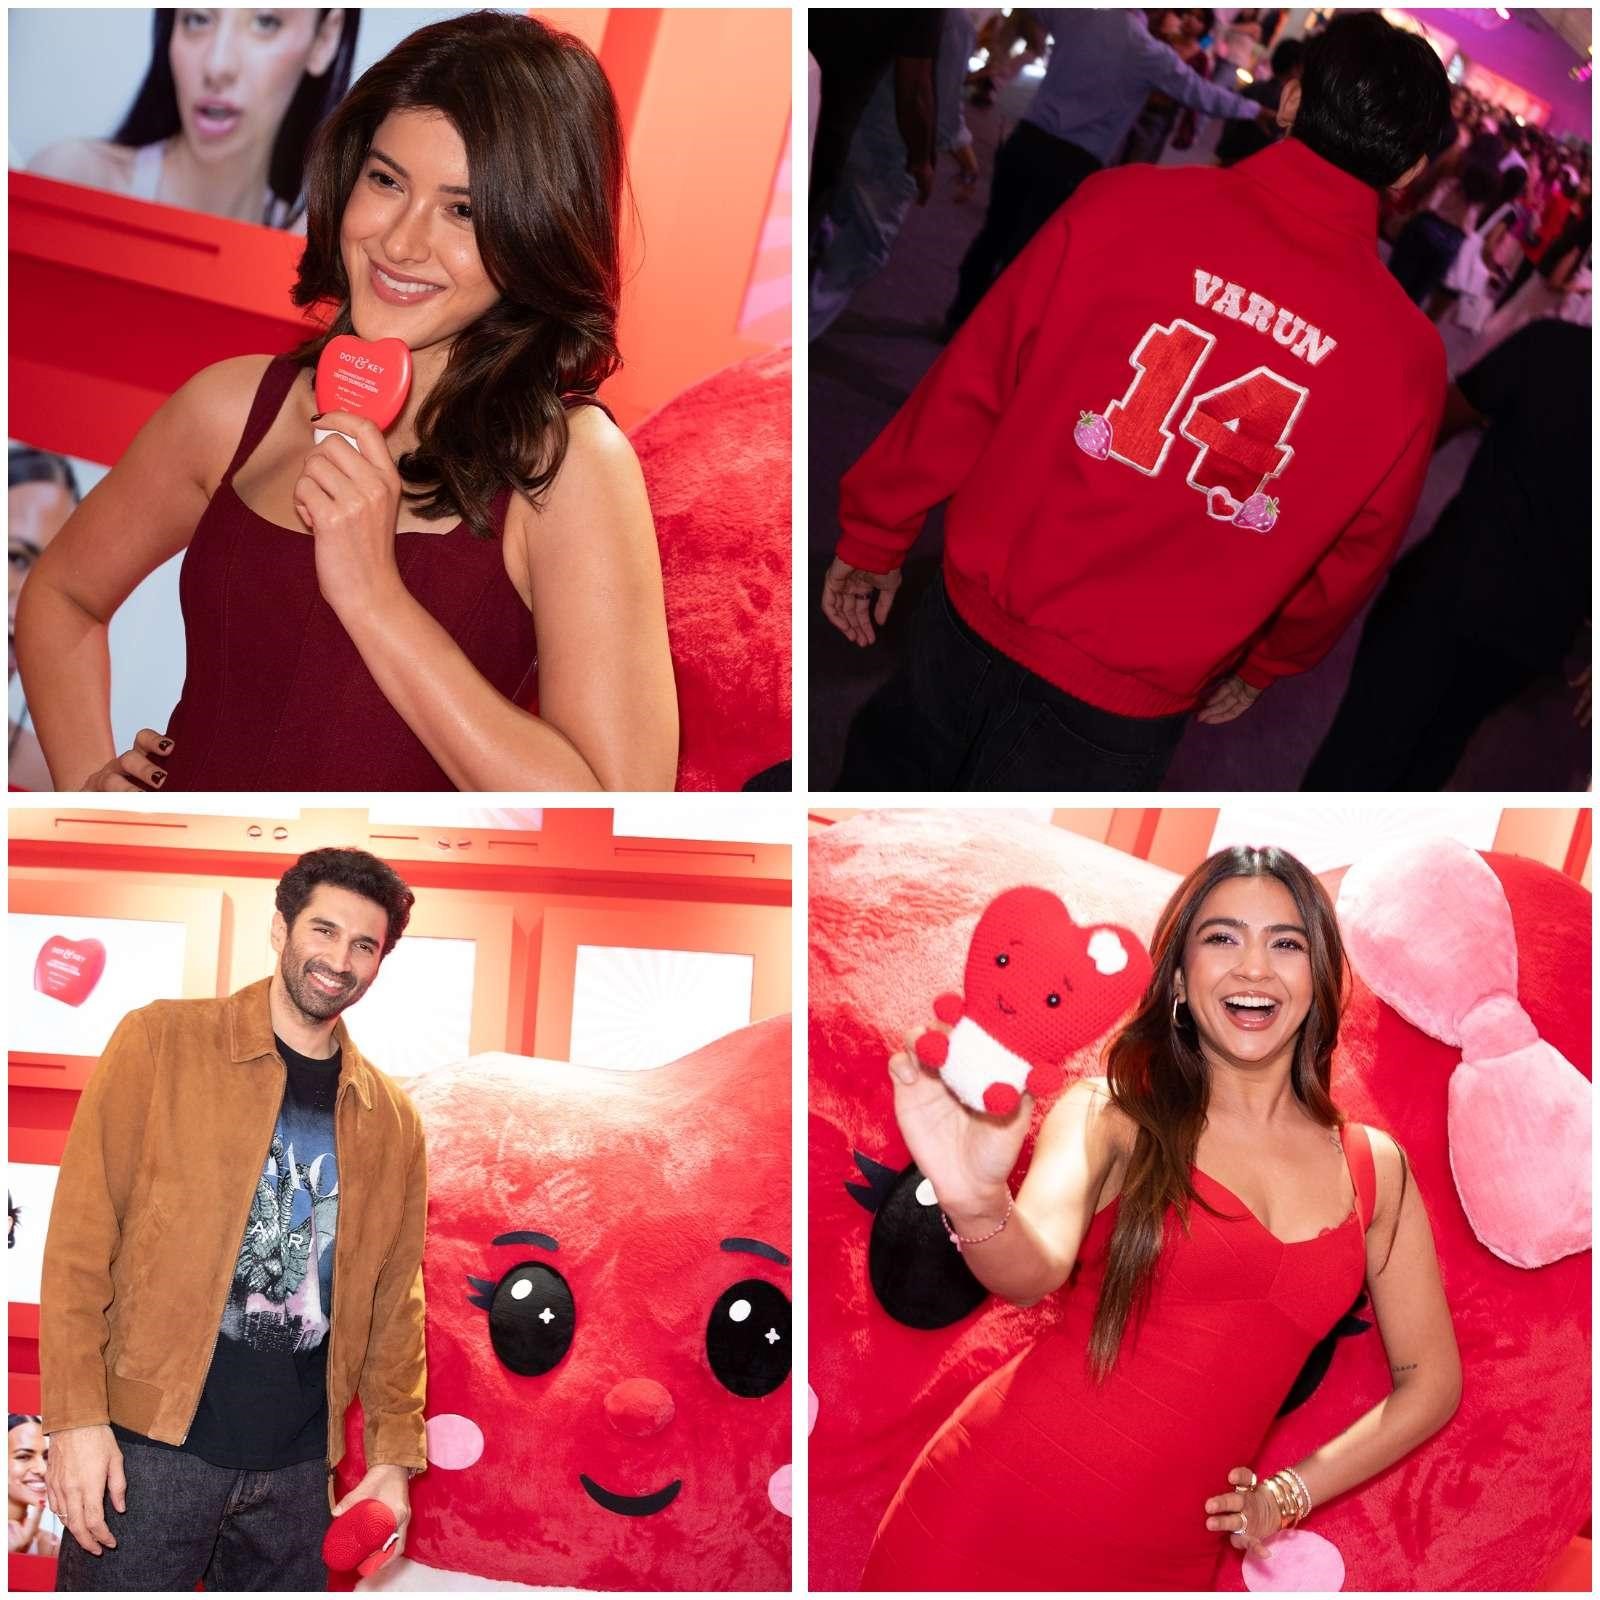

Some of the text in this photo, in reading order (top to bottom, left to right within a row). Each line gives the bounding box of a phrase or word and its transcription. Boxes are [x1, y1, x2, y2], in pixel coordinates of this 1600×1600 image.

[339, 352, 385, 374] DOT & KEY
[1193, 268, 1337, 366] VARUN
[1103, 318, 1310, 507] 14
